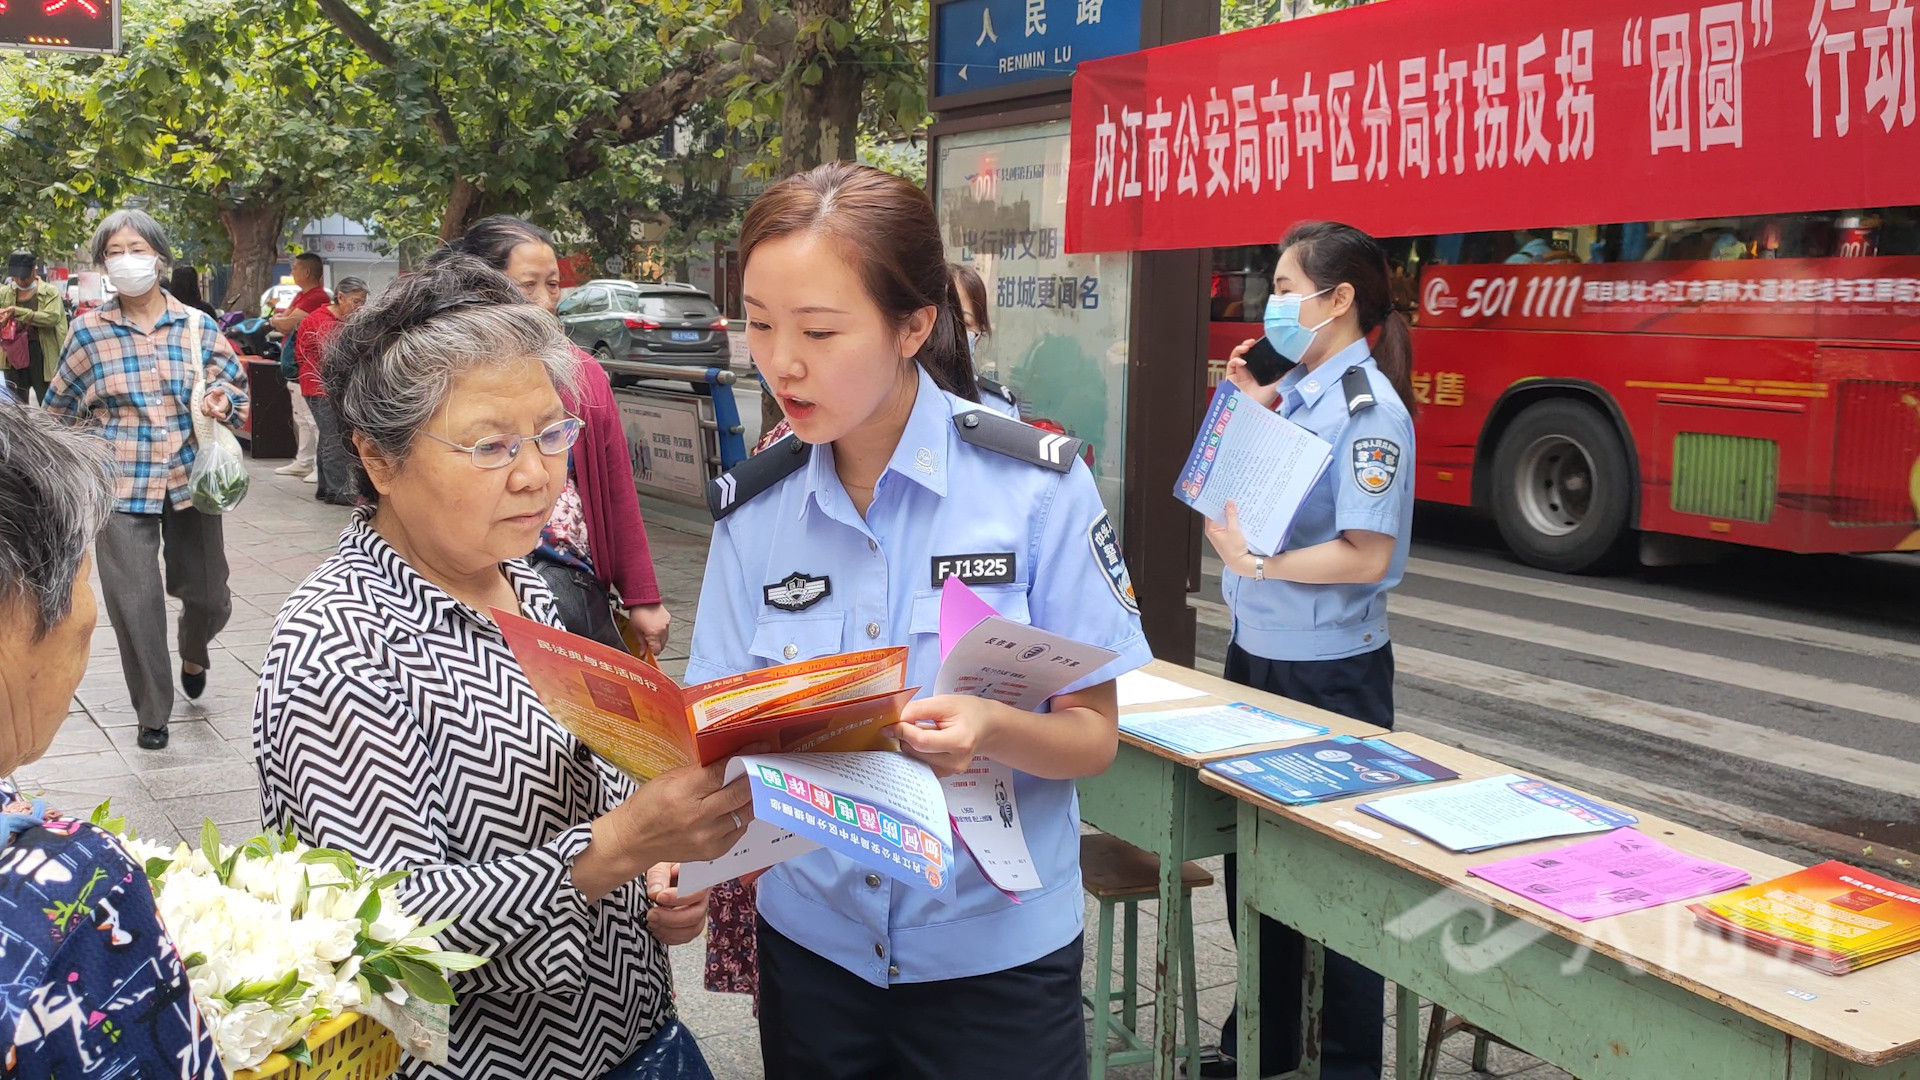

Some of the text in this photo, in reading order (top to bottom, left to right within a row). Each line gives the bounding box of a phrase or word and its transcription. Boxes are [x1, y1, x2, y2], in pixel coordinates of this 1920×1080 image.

[976, 0, 1102, 47] 人民路
[999, 45, 1072, 74] RENMIN LU
[962, 227, 1058, 262] 出行讲文明
[997, 275, 1100, 310] 甜城更闻名
[1461, 276, 1582, 317] 501 1111
[937, 557, 1008, 580] FJ1325
[536, 638, 659, 693] 民法典与生活同行
[759, 766, 942, 862] 如何防范电信诈骗
